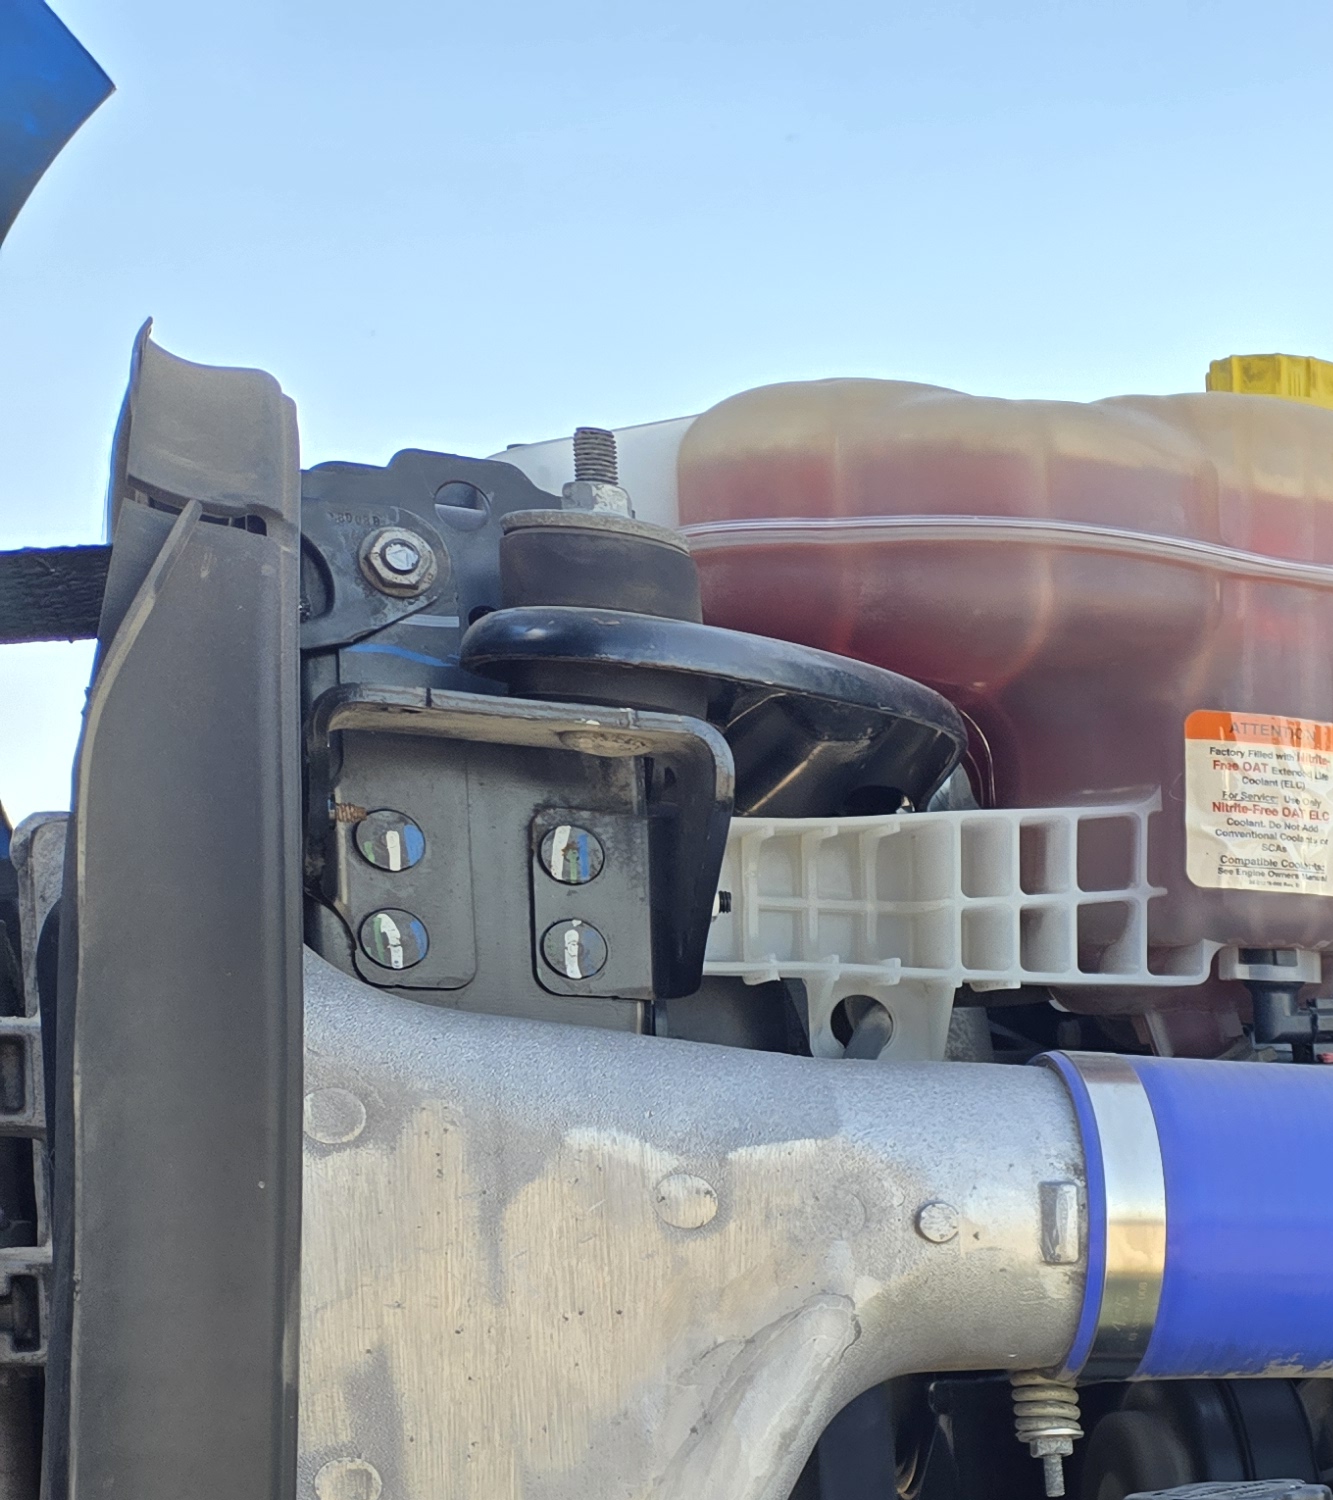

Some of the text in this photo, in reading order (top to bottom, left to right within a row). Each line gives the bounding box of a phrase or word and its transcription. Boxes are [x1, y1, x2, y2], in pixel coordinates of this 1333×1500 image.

[1229, 721, 1317, 741] ATTENTION
[1209, 746, 1246, 759] Factory
[1248, 749, 1274, 760] Filled
[1275, 750, 1294, 762] with
[1213, 759, 1240, 771] Free
[1242, 761, 1269, 774] OAT
[1241, 775, 1306, 791] Coolant (ELC)
[1222, 789, 1239, 801] For
[1212, 801, 1330, 822] Nitrite-Free OAT ELC
[1268, 820, 1282, 830] Do
[1284, 821, 1300, 832] Not
[1301, 823, 1319, 834] Add
[1215, 828, 1278, 842] Conventional
[1219, 854, 1278, 870] Compatible
[1218, 867, 1235, 876] See
[1235, 868, 1266, 879] Engine
